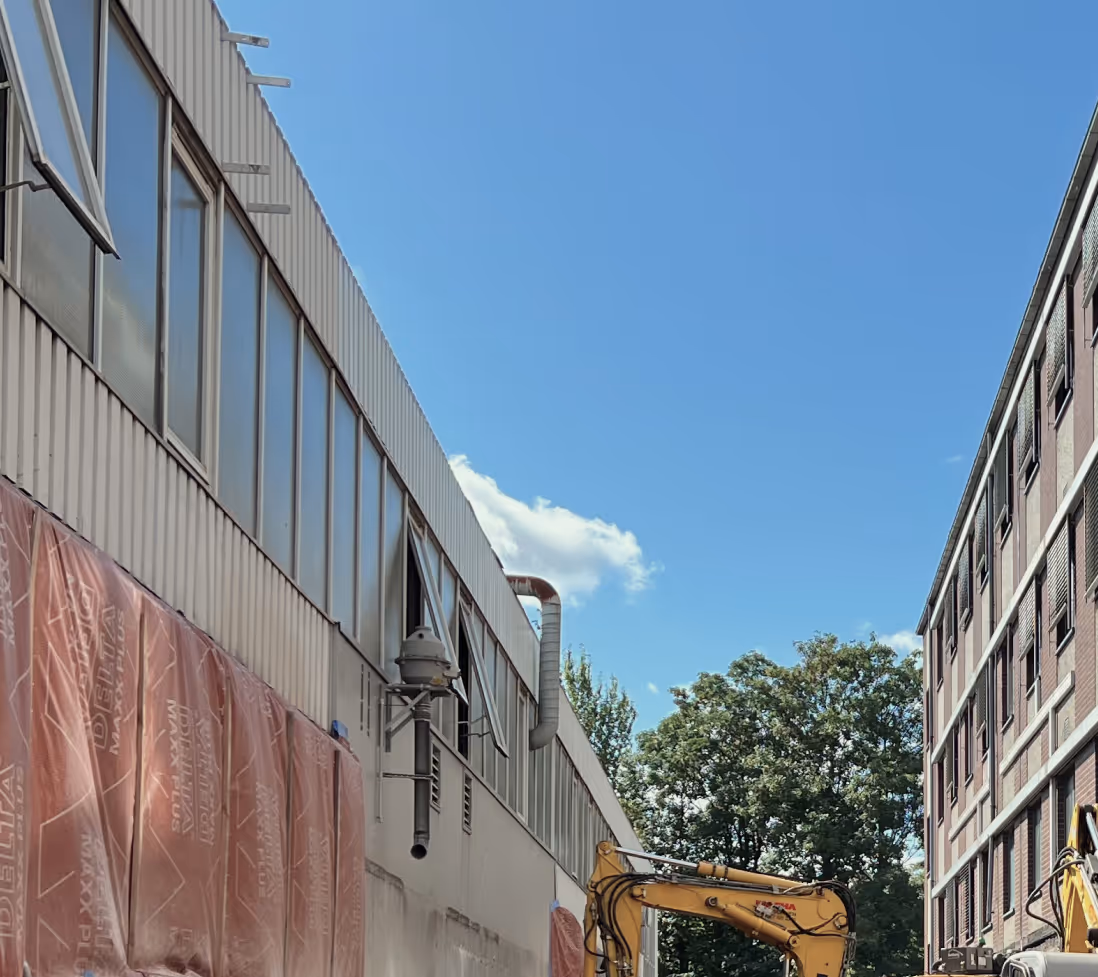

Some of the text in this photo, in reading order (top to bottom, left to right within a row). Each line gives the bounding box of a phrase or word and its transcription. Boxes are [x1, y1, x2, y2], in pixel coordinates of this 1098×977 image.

[92, 605, 116, 750] DELTA
[109, 683, 123, 755] MAXX
[167, 699, 182, 833] MAXX PLUS
[74, 924, 92, 974] PLU
